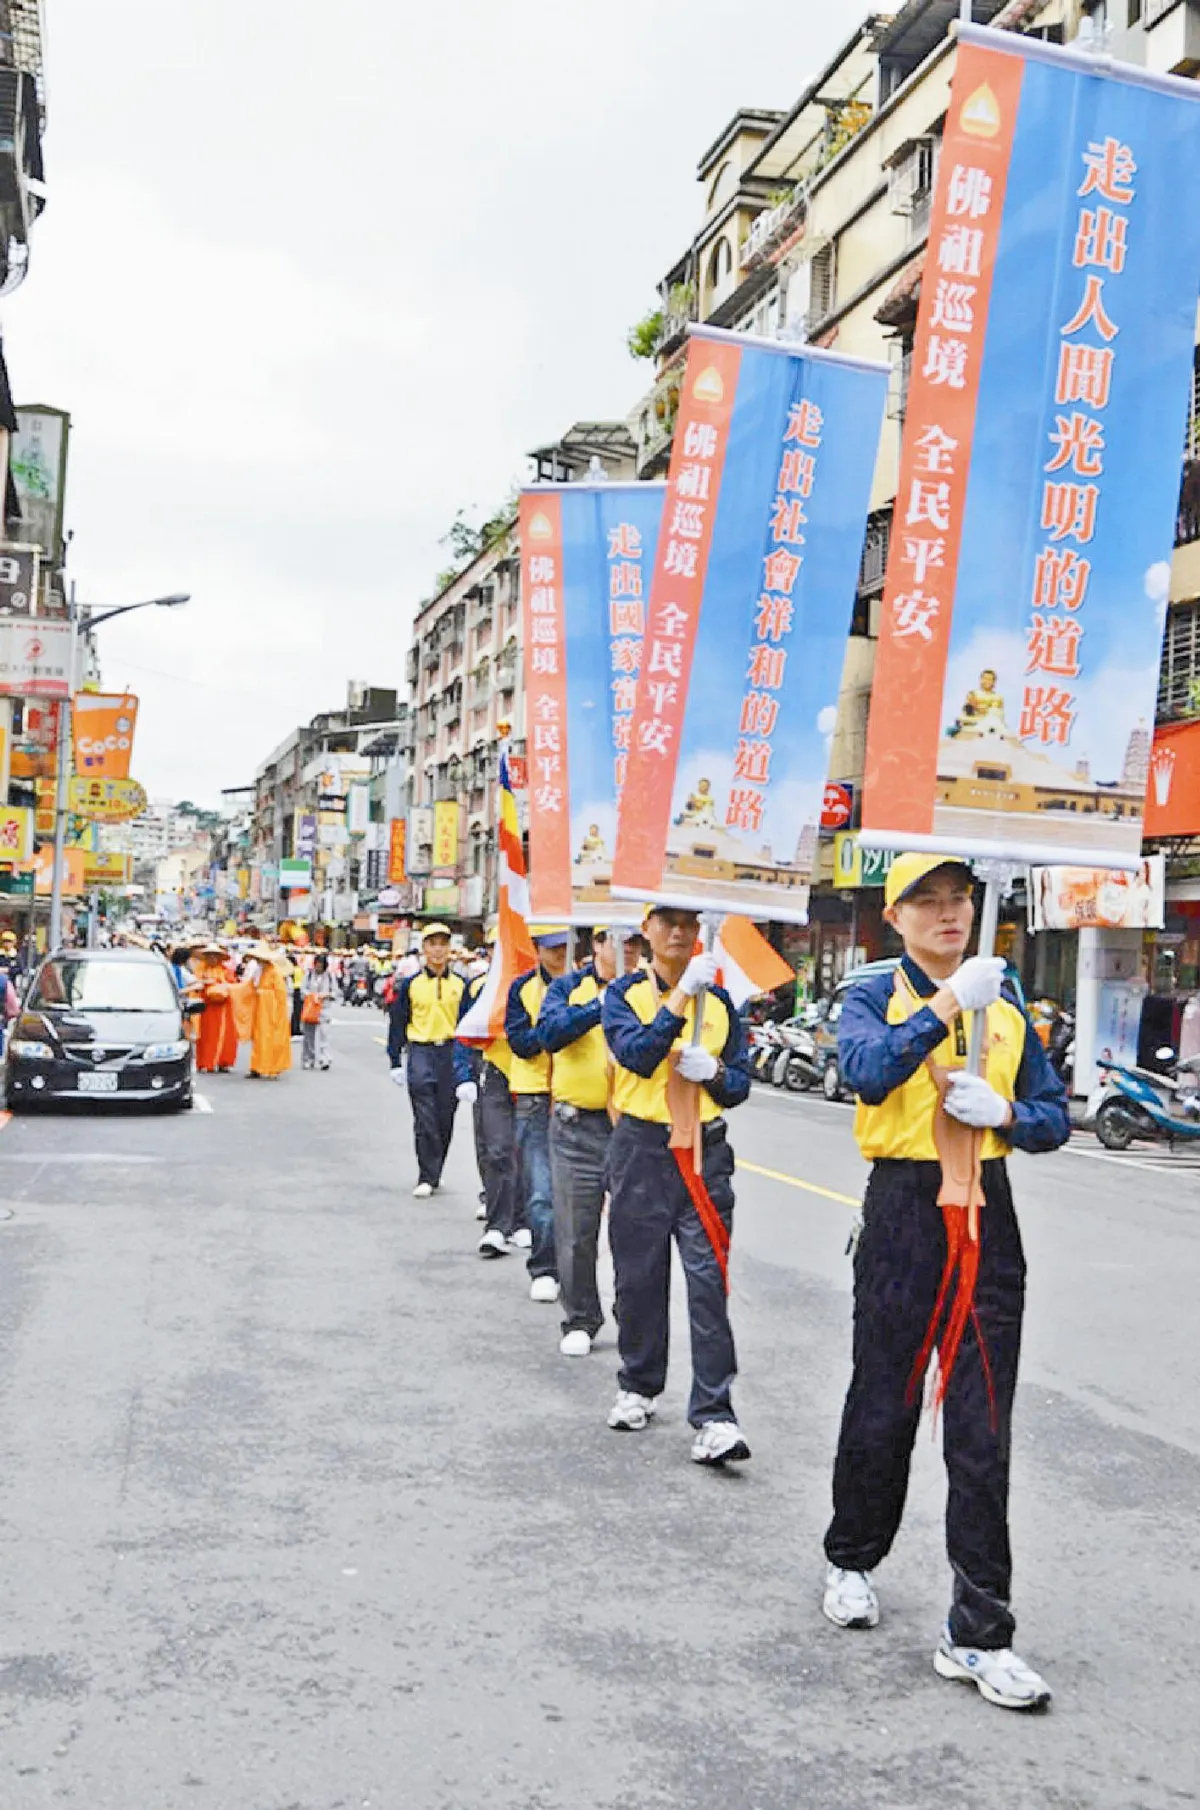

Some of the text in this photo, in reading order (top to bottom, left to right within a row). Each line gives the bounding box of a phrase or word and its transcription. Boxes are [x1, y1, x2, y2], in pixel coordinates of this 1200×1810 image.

[638, 421, 717, 754] 佛祖巡境 全民平安
[891, 164, 994, 641] 佛祖巡境 全民平安
[1018, 136, 1137, 745] 走出人間光明的道路
[529, 556, 562, 812] 佛祖巡境 全民平安
[607, 523, 644, 812] 走出國家富強
[725, 399, 823, 831] 走出社會祥和的道路
